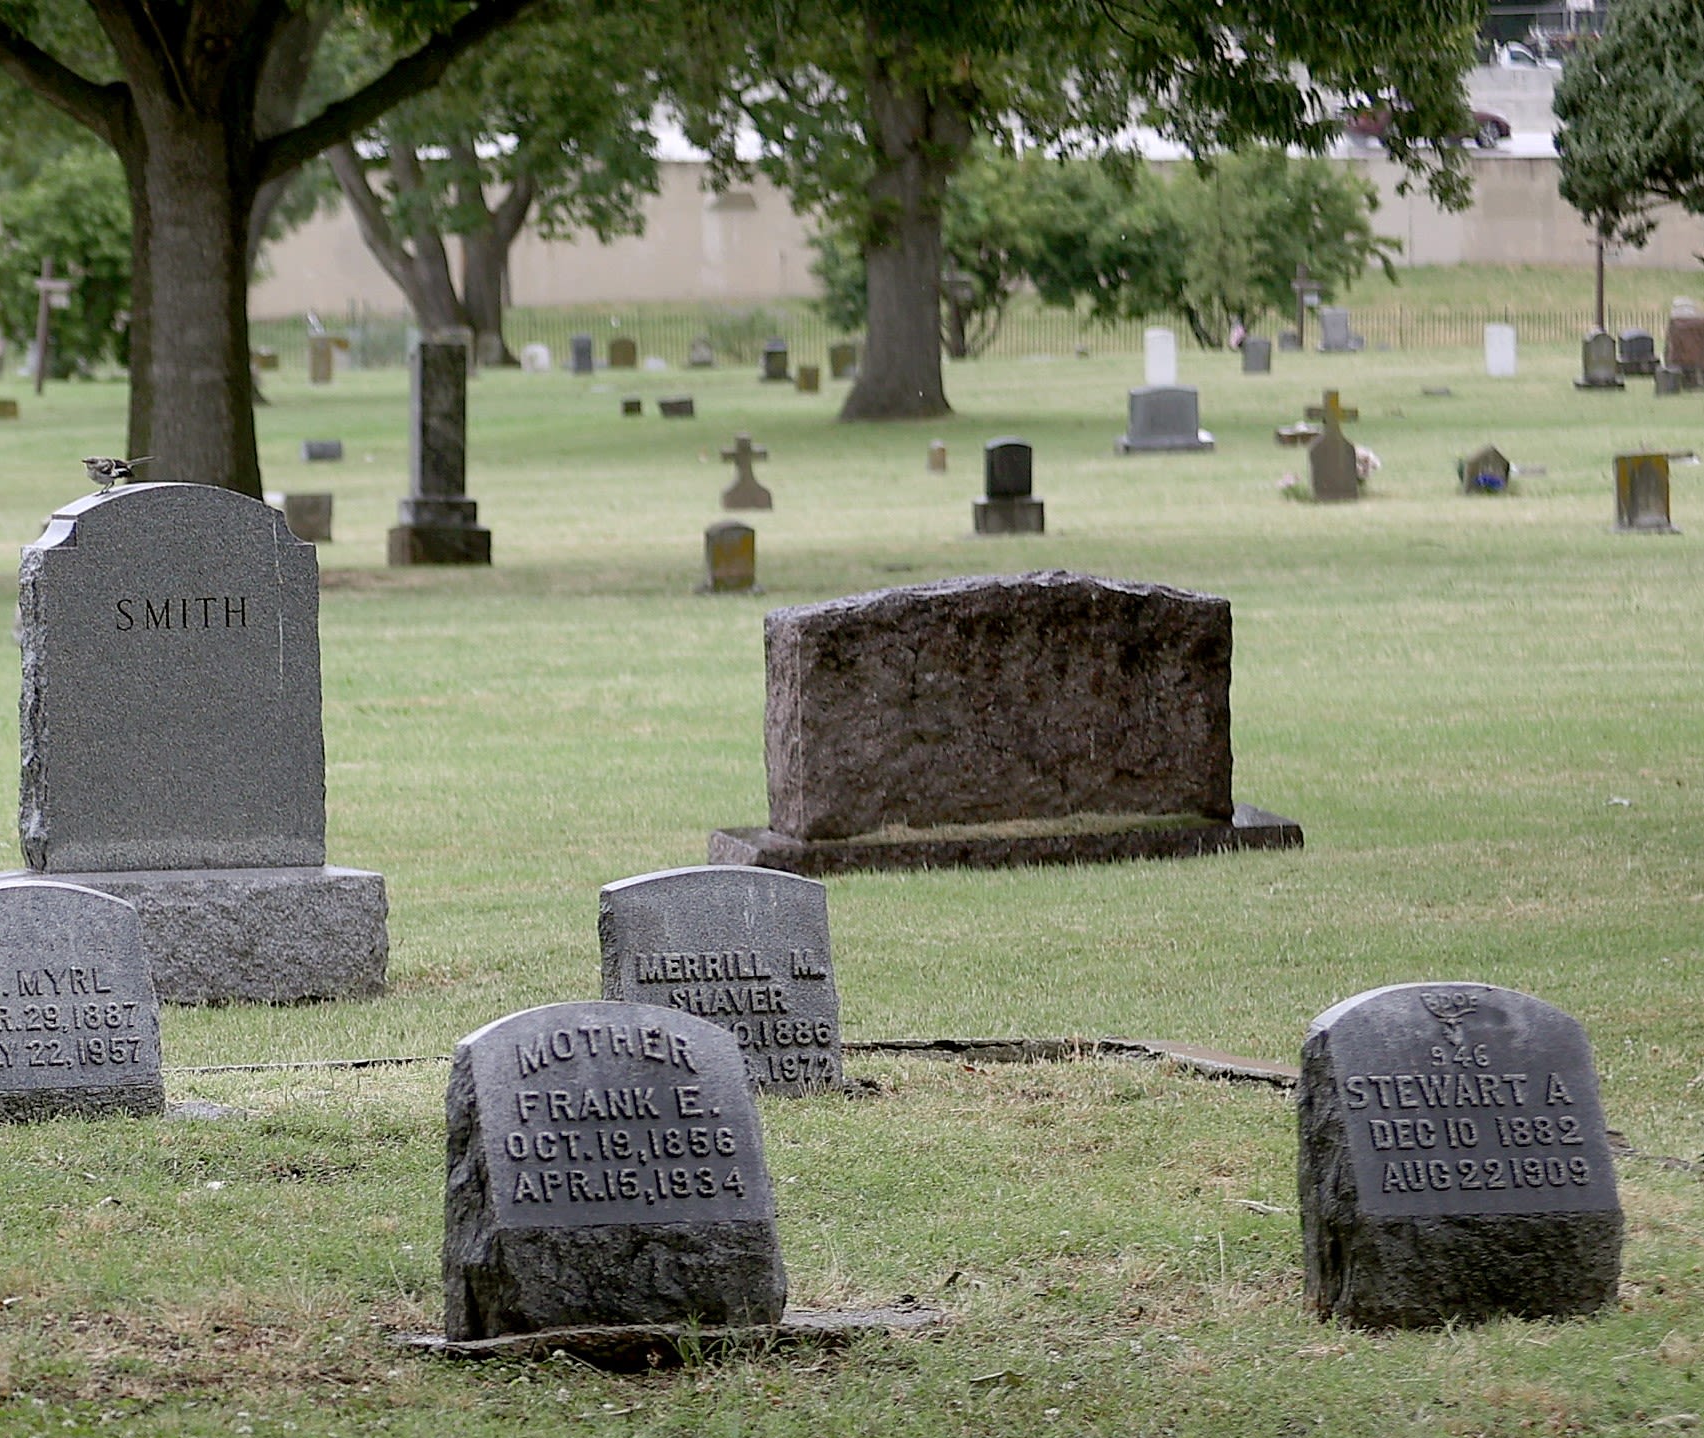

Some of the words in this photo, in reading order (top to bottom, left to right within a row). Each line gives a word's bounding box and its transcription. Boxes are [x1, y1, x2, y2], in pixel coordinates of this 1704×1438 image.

[116, 596, 249, 632] SMITH
[635, 951, 771, 983] MERRILL
[671, 985, 789, 1017] SHAVER
[516, 1025, 698, 1079] MOTHER
[516, 1087, 661, 1122] FRANK
[673, 1085, 721, 1119] E.
[1344, 1073, 1528, 1110] STEWART
[1546, 1071, 1575, 1106] A
[1369, 1118, 1436, 1152] DEC
[1444, 1117, 1480, 1150] 10
[1495, 1115, 1585, 1149] 1882
[1382, 1159, 1452, 1194] AUG
